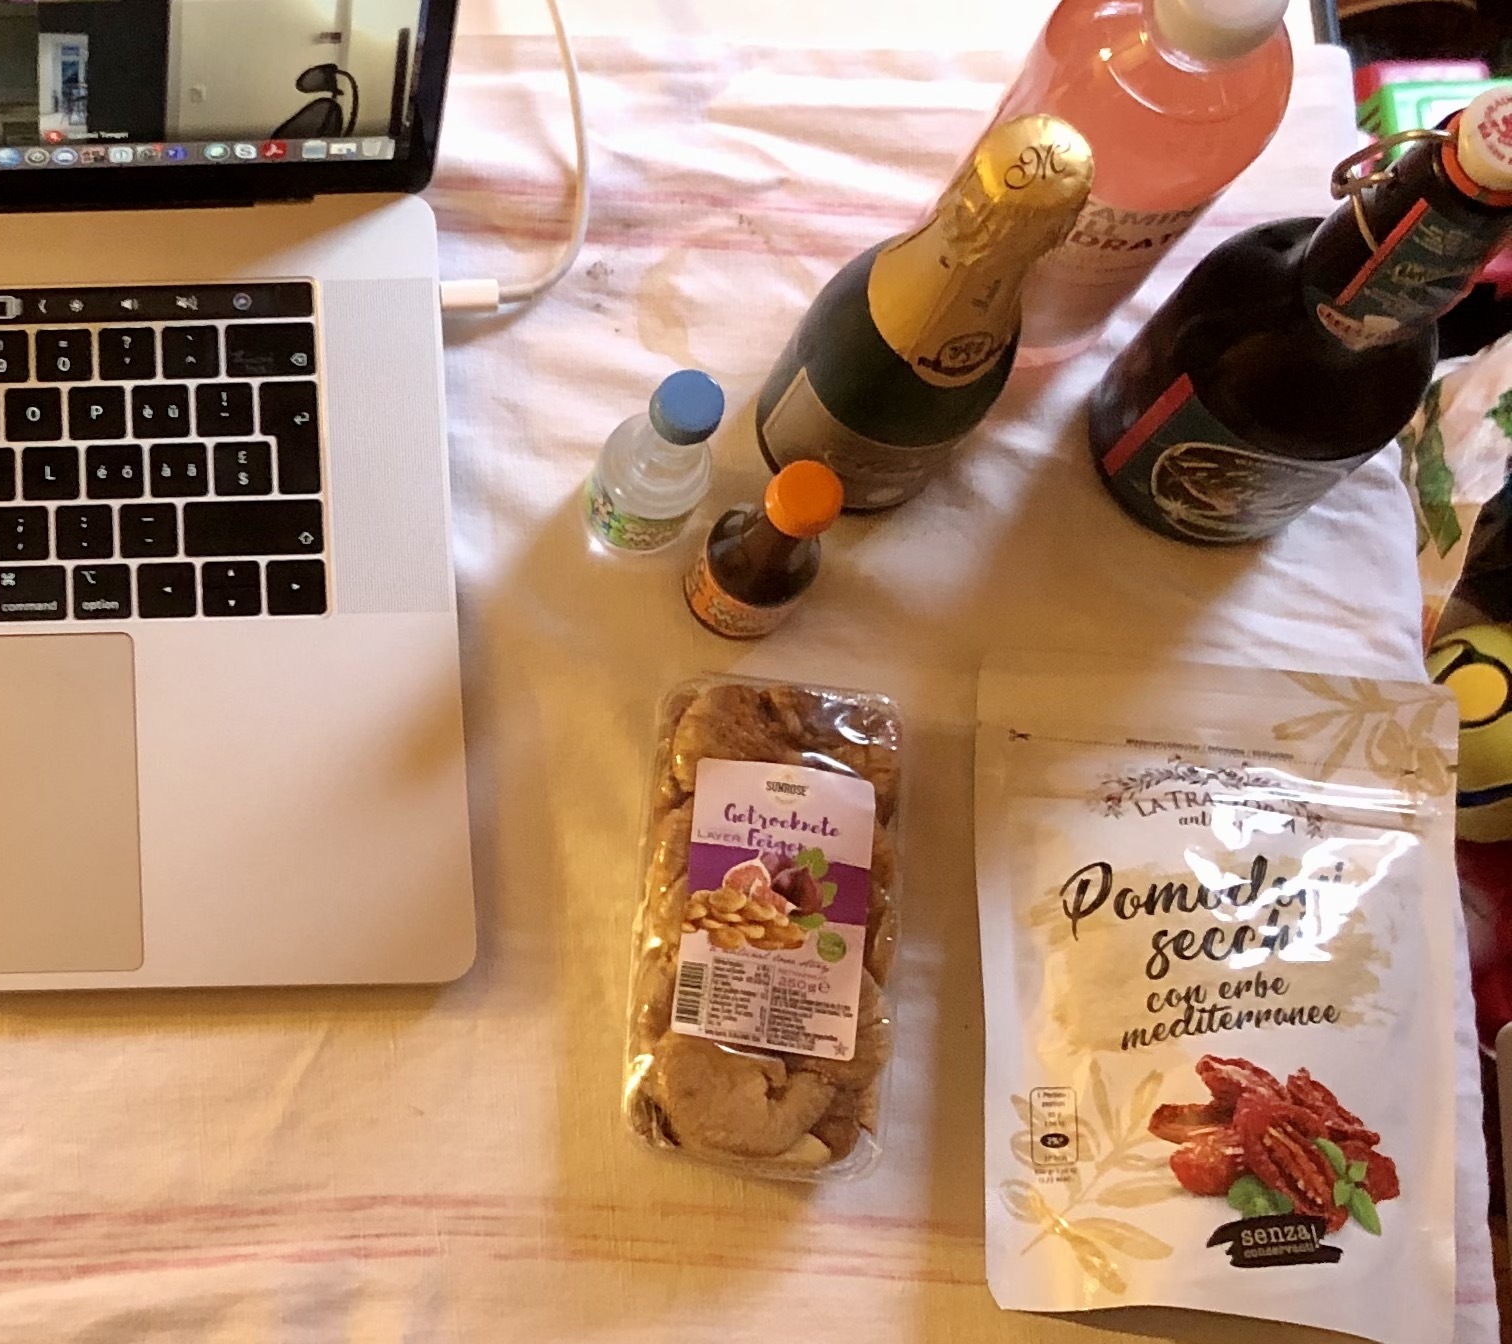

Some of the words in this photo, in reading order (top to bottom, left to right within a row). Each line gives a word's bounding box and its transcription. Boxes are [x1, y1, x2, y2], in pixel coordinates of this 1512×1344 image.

[56, 356, 71, 372] 0
[25, 406, 41, 422] O
[90, 405, 104, 420] P
[44, 465, 56, 481] L
[1145, 908, 1310, 980] secch
[1147, 984, 1207, 1013] con
[1218, 971, 1290, 1002] erbe
[1120, 1002, 1342, 1051] mediterranee
[1240, 1224, 1312, 1246] senza
